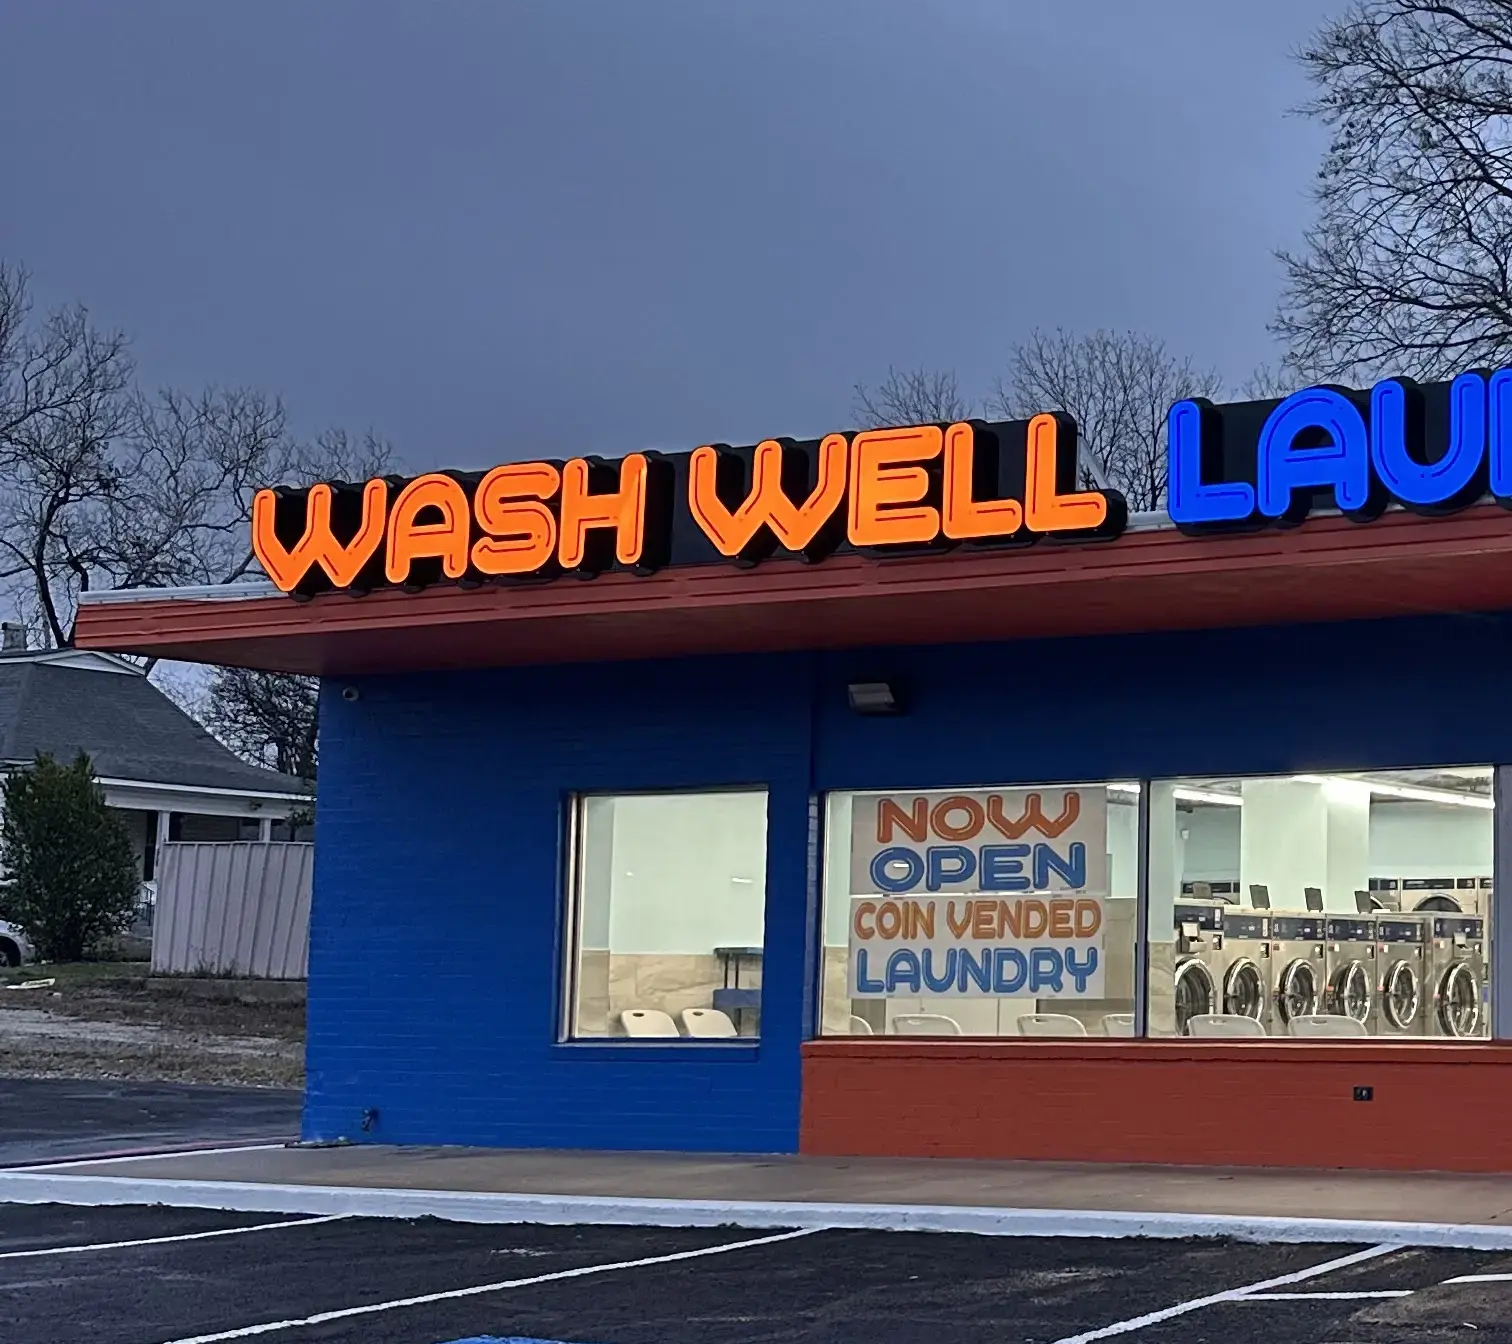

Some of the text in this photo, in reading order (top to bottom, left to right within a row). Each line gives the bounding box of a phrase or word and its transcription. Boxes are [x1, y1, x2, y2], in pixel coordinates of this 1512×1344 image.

[252, 413, 1107, 592] WASH WELL
[876, 792, 1080, 844] NOW
[870, 842, 1086, 892] OPEN
[854, 899, 1102, 940] COIN VENDED
[856, 947, 1098, 994] LAUNDRY
